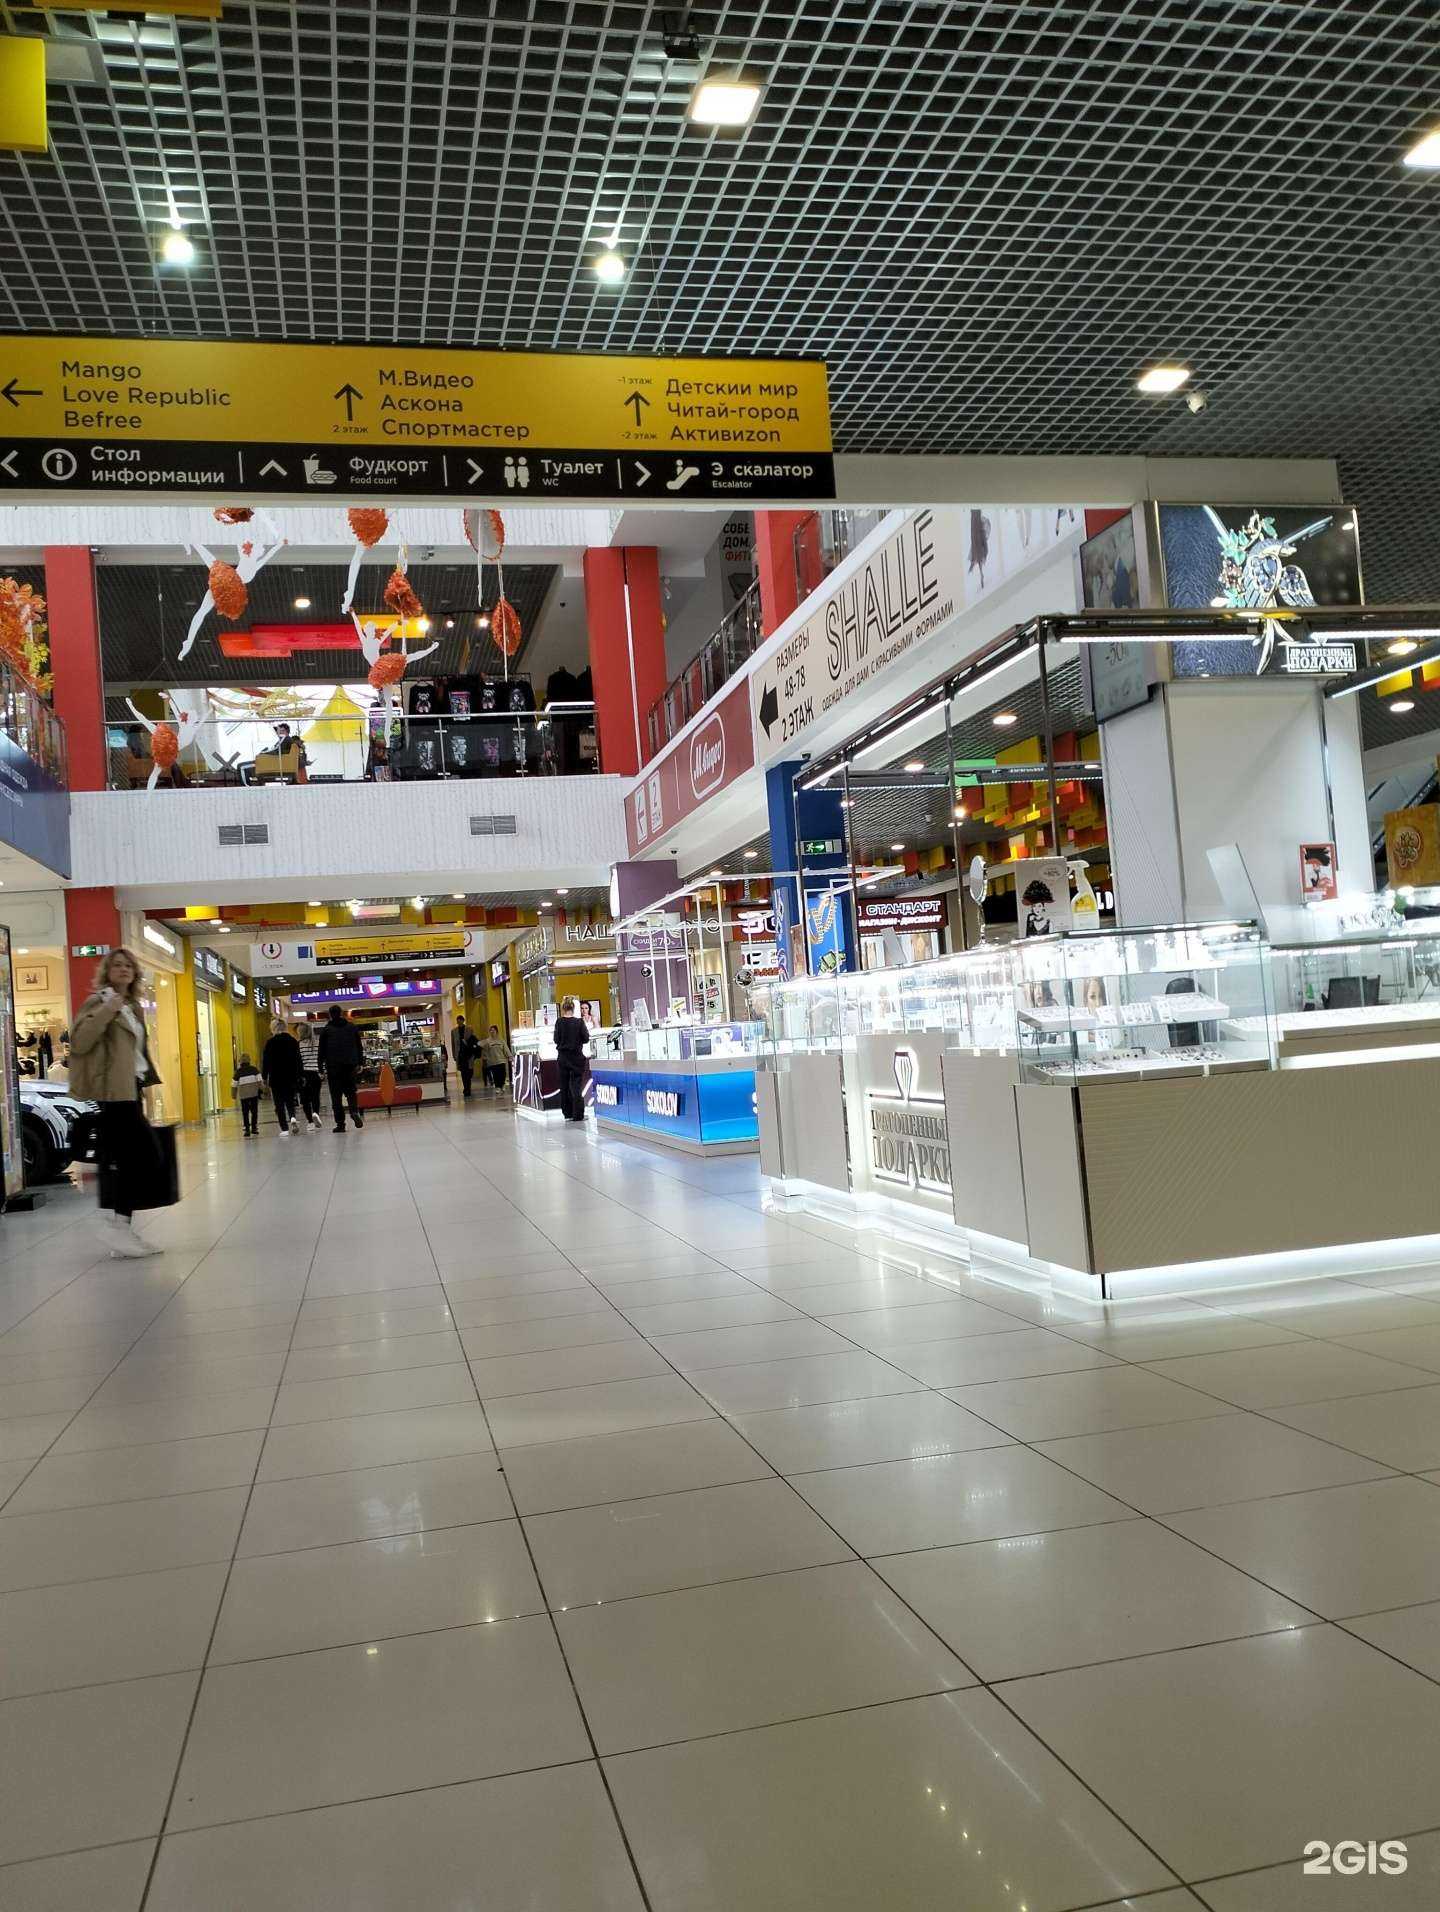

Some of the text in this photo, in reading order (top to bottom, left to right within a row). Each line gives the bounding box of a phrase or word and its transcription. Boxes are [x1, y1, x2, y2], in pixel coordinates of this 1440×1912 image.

[61, 361, 141, 381] Mango
[379, 369, 474, 389] М.Видео
[63, 386, 231, 410] Love Republic
[759, 384, 798, 400] мир
[381, 395, 463, 412] Аскона
[668, 402, 800, 422] Читай-город
[64, 411, 142, 429] Befree
[382, 419, 530, 440] Спортмастер
[670, 425, 781, 442] Активиzon
[91, 446, 141, 461] Стол
[349, 456, 429, 475] Фудкорт
[541, 459, 604, 479] Туалет
[734, 464, 814, 479] скалатор
[91, 467, 225, 485] информации
[350, 476, 397, 485] Food court
[712, 481, 752, 489] Escalator
[825, 508, 939, 681] SHALLE
[776, 627, 810, 675] РАЗМЕРЫ
[856, 665, 869, 688] ДАМ
[876, 631, 914, 671] КРАСИВЫМИ
[915, 598, 954, 638] ФОРМАМИ
[1289, 656, 1353, 672] ПОДАРКИ
[784, 665, 806, 700] 48-78
[781, 696, 814, 742] 2 ЭТАЖ
[866, 901, 941, 915] СТАНДАРТ
[646, 1090, 678, 1117] SOKOLOV
